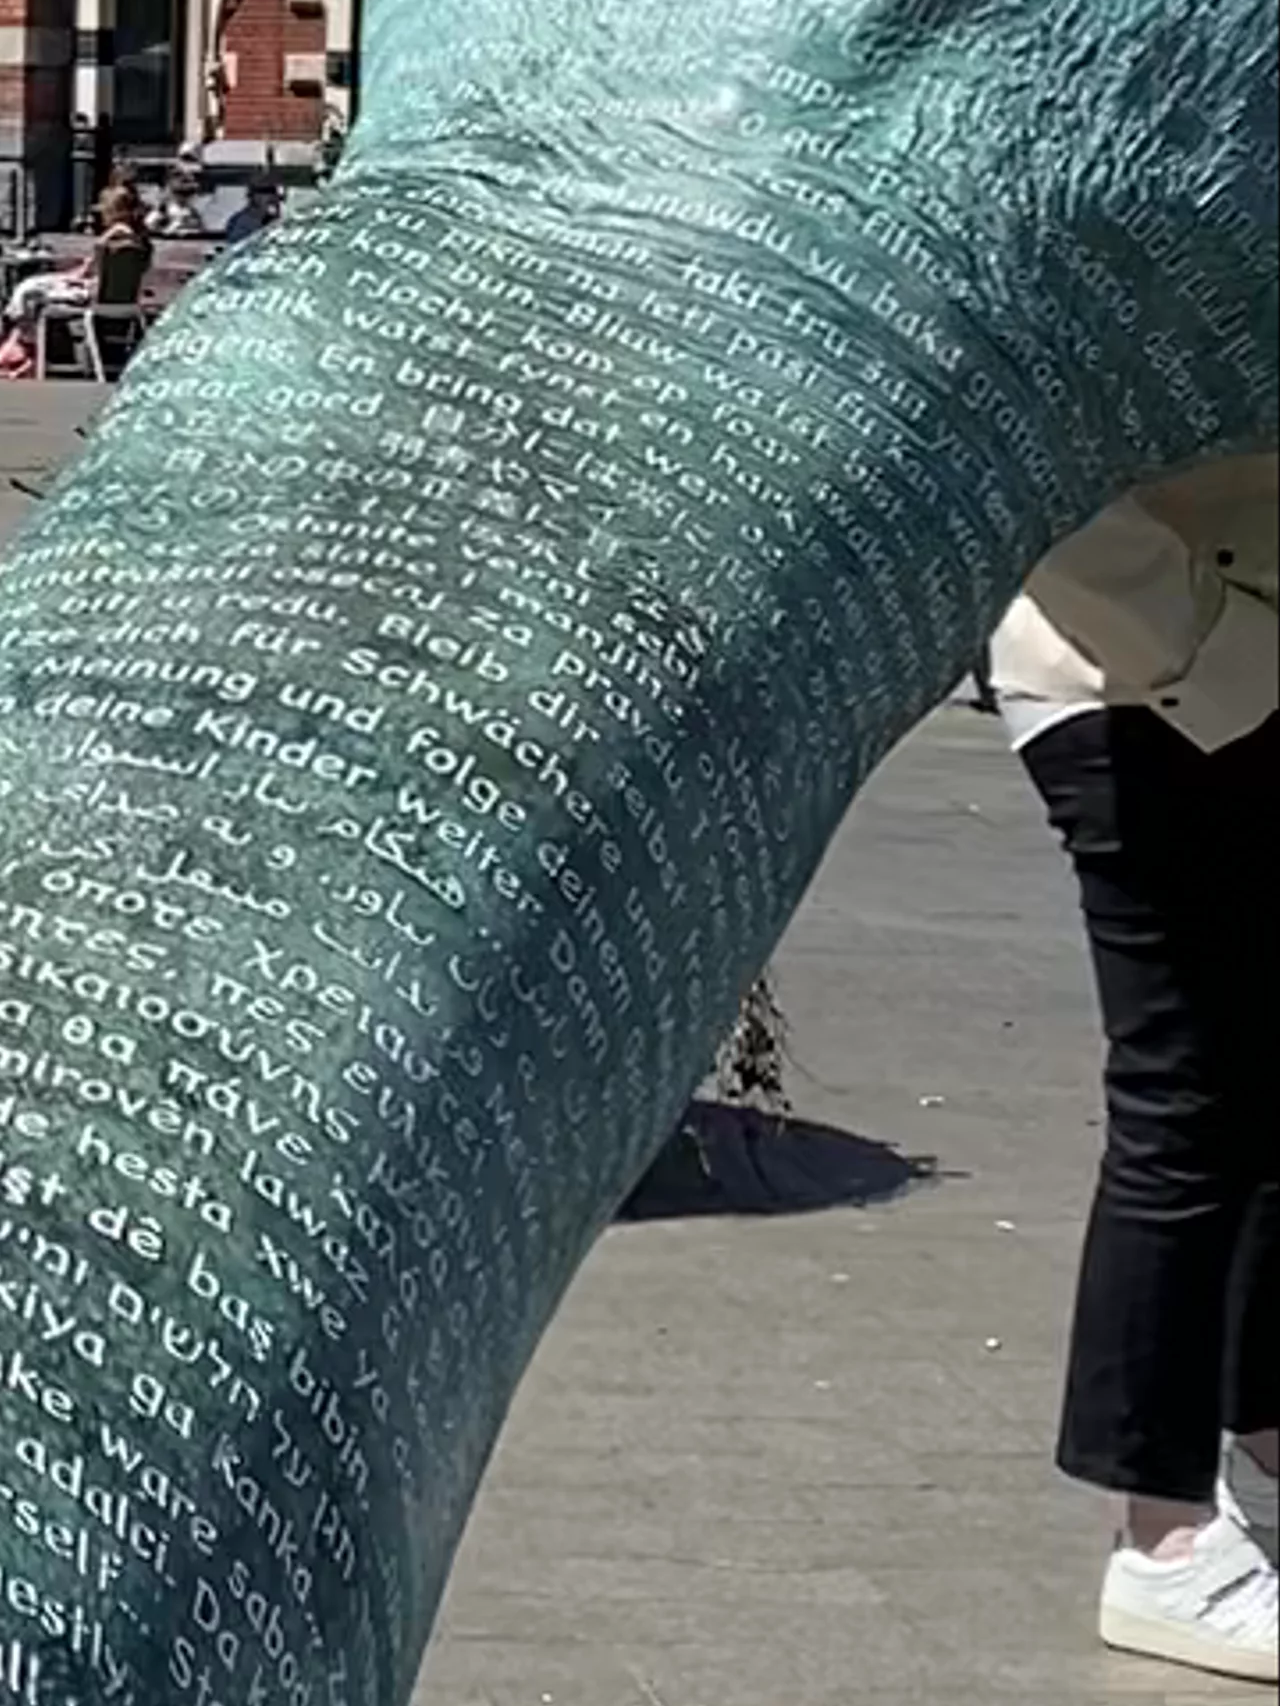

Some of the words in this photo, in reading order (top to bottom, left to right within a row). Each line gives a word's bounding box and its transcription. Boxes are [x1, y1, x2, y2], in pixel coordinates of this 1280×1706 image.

[33, 655, 259, 704] Meinung
[278, 682, 389, 736] und
[405, 727, 528, 833] folge
[193, 709, 379, 789] Kinder
[130, 1373, 196, 1440] ga
[99, 1424, 221, 1558] ware
